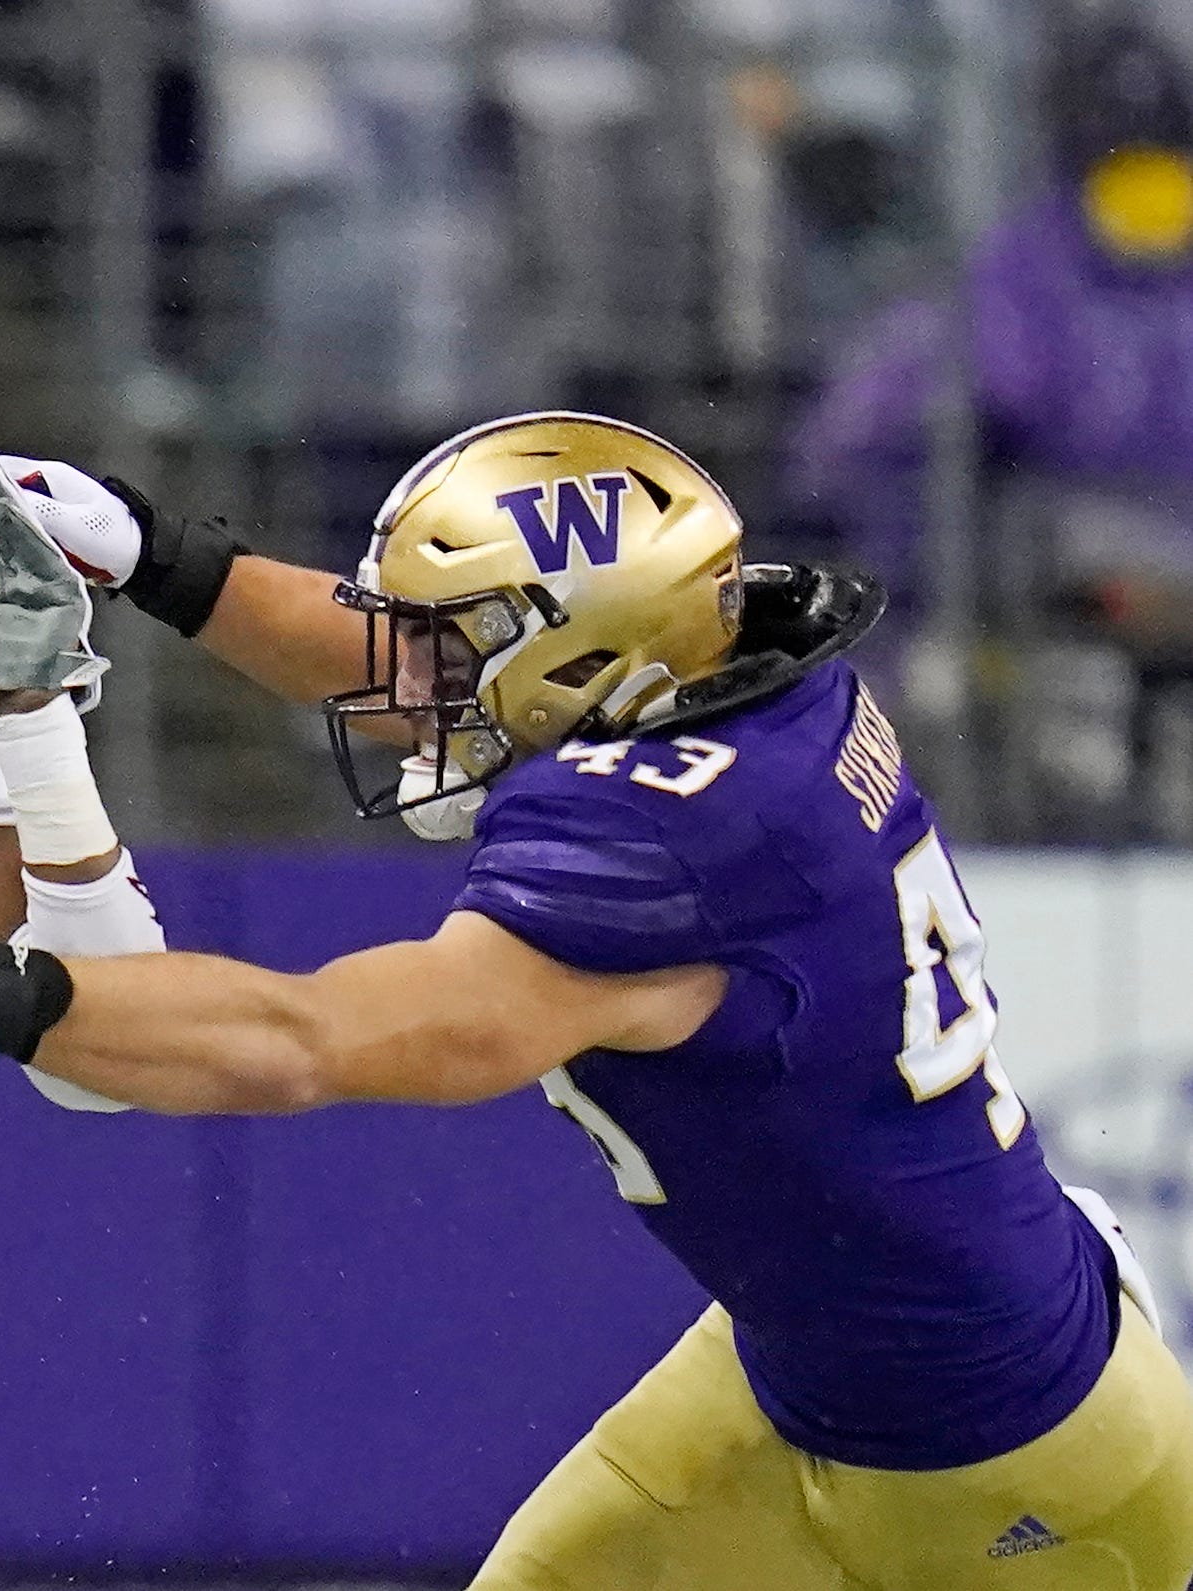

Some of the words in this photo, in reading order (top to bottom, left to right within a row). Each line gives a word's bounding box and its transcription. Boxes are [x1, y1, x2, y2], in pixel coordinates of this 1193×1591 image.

[494, 473, 632, 576] W
[556, 736, 738, 798] 43
[893, 825, 1028, 1151] 4
